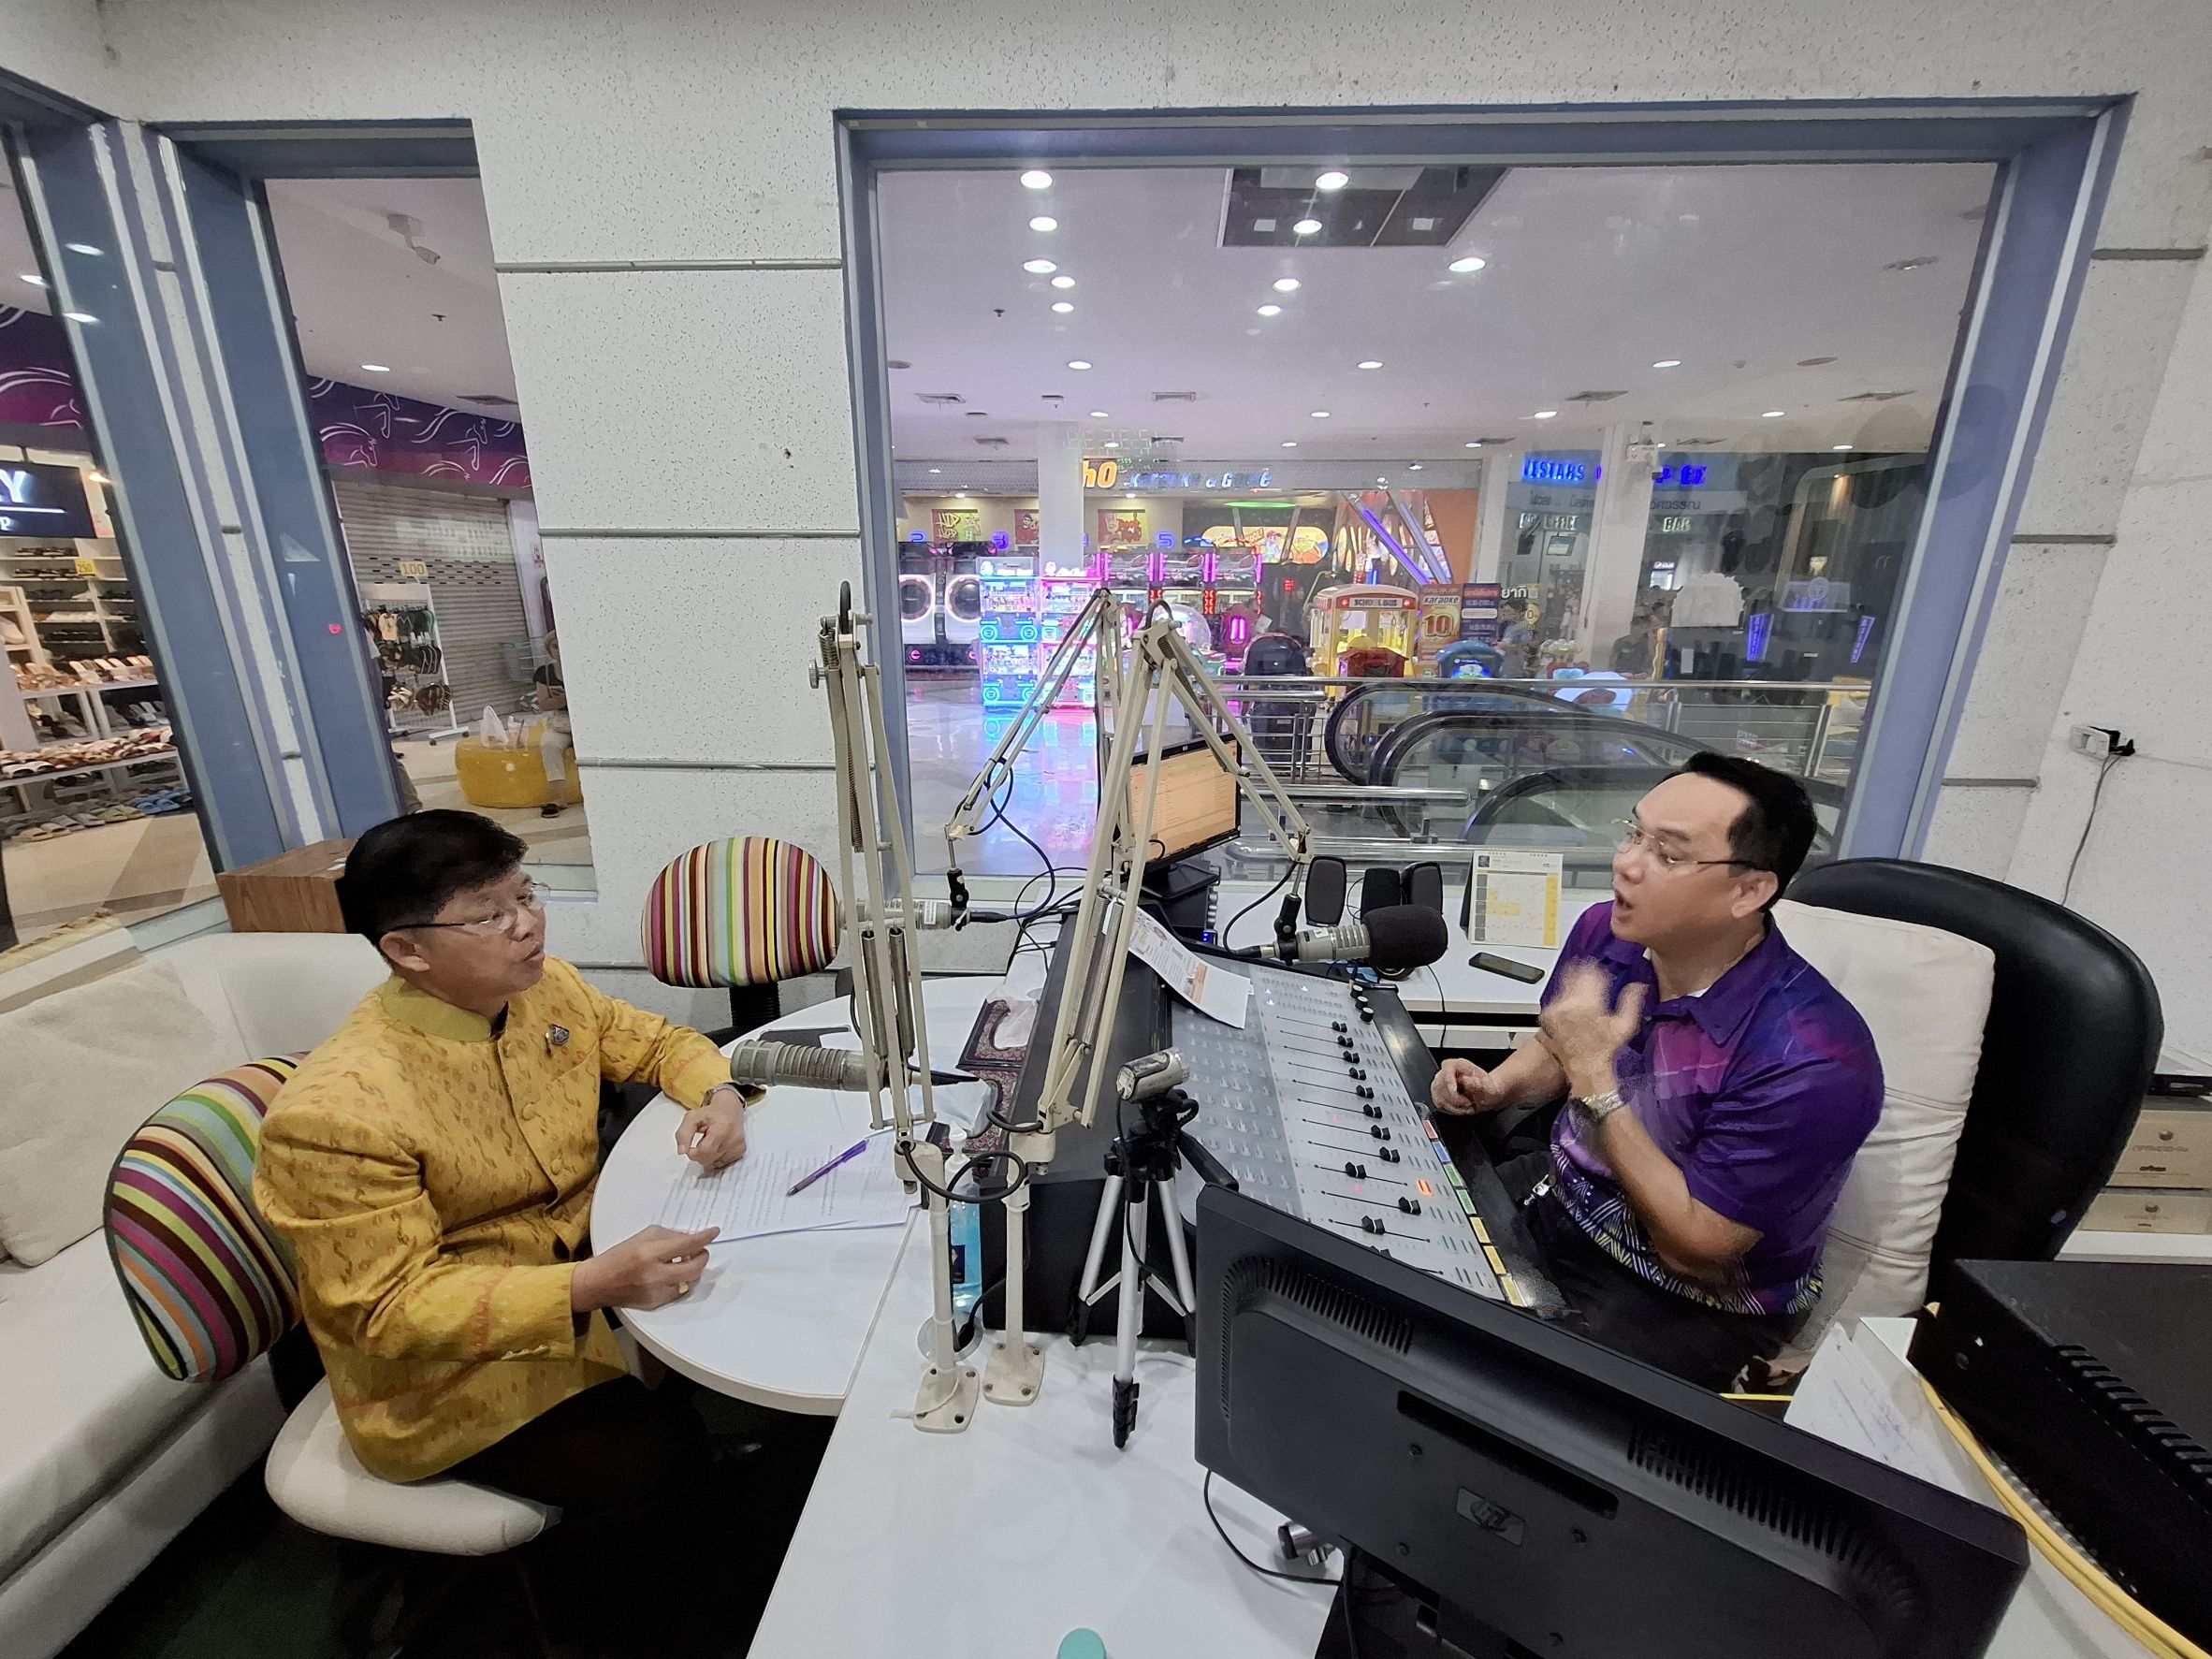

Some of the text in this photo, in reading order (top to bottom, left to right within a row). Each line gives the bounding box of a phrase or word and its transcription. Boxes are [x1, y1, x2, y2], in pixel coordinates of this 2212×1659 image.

[0, 470, 29, 503] Y
[401, 562, 425, 575] 100
[1354, 599, 1381, 607] SCHOL
[1424, 614, 1453, 636] 10
